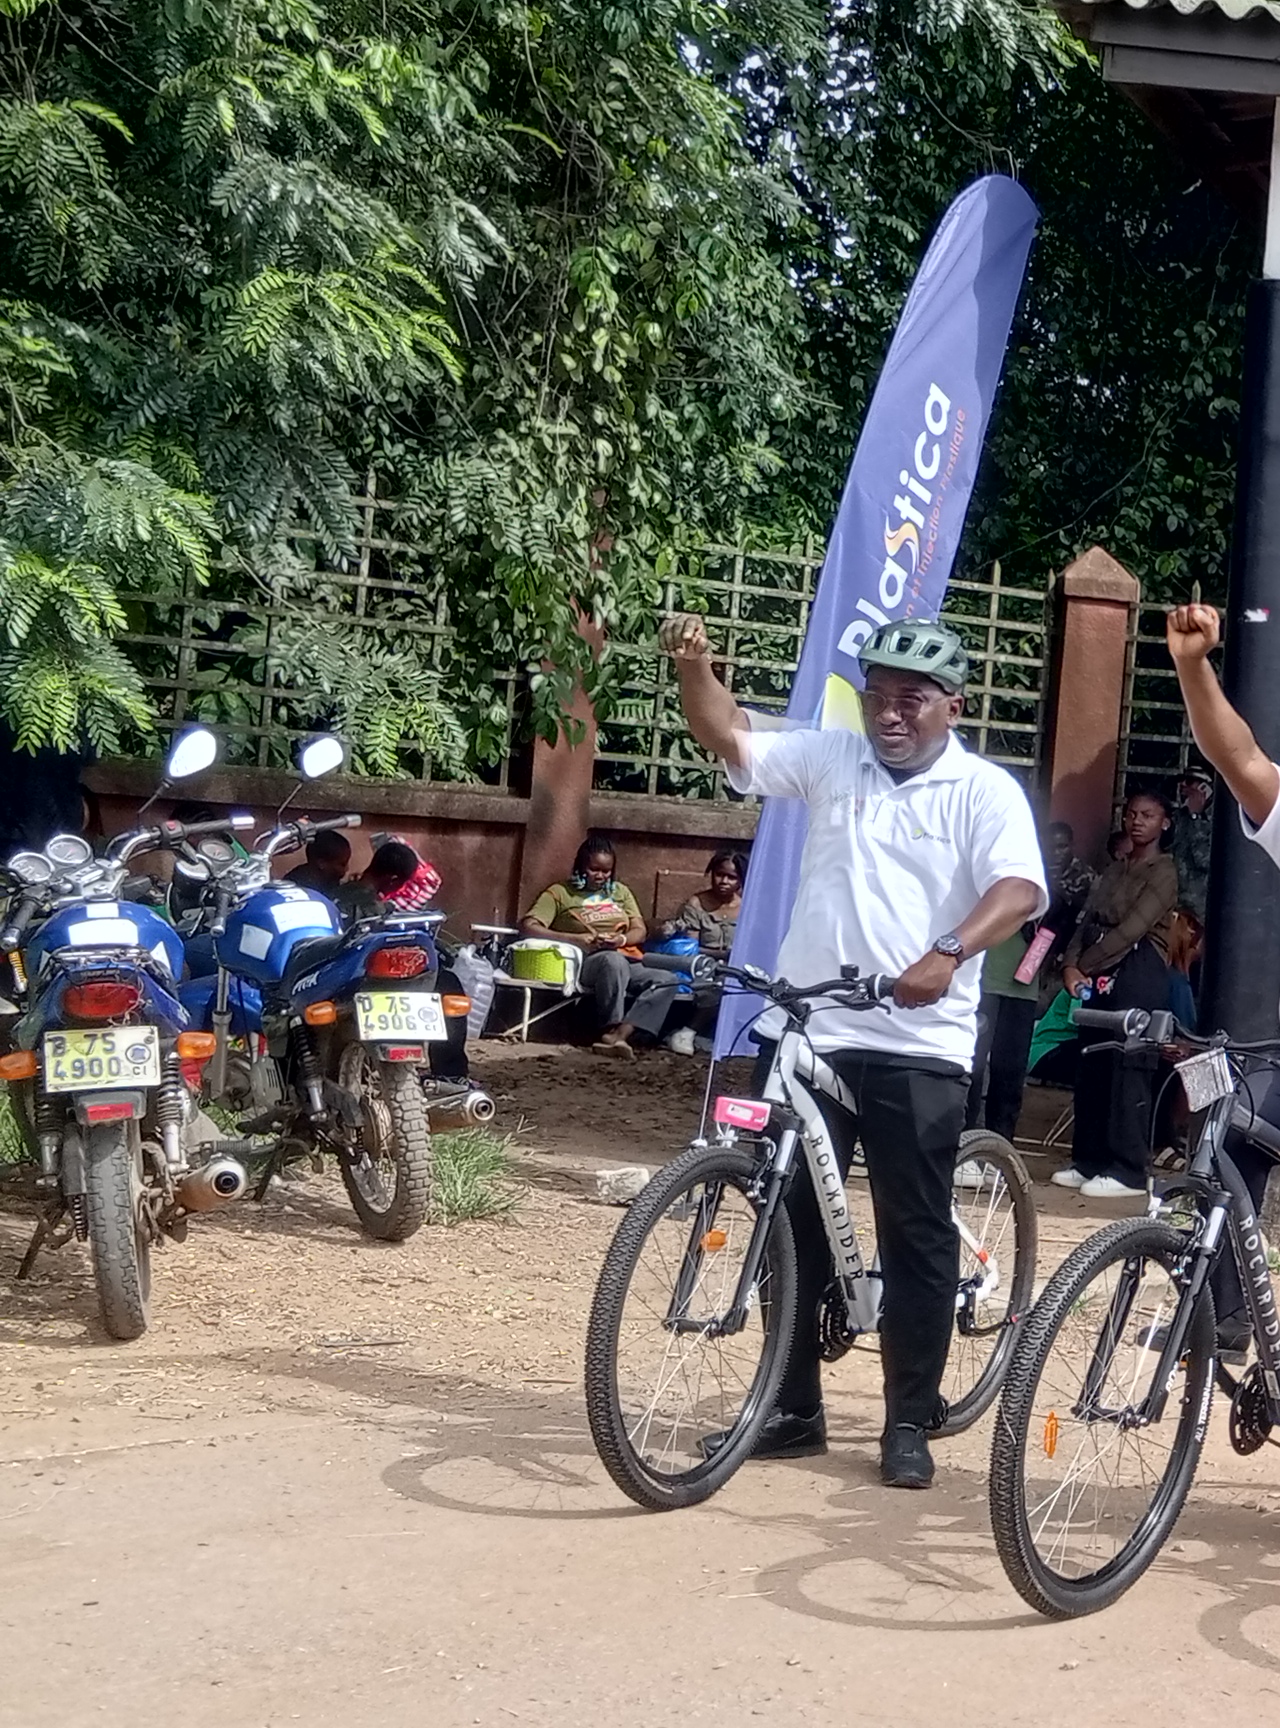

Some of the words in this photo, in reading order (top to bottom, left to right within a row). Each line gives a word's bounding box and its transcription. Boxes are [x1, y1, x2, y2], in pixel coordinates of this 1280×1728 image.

[916, 495, 944, 577] Injection
[939, 408, 966, 491] Plastique
[837, 381, 952, 661] Plastica
[385, 995, 412, 1013] 75
[363, 1013, 418, 1032] 4906
[83, 1031, 117, 1056] 75
[53, 1056, 122, 1082] 4900
[810, 1134, 865, 1280] ROCKRIDER
